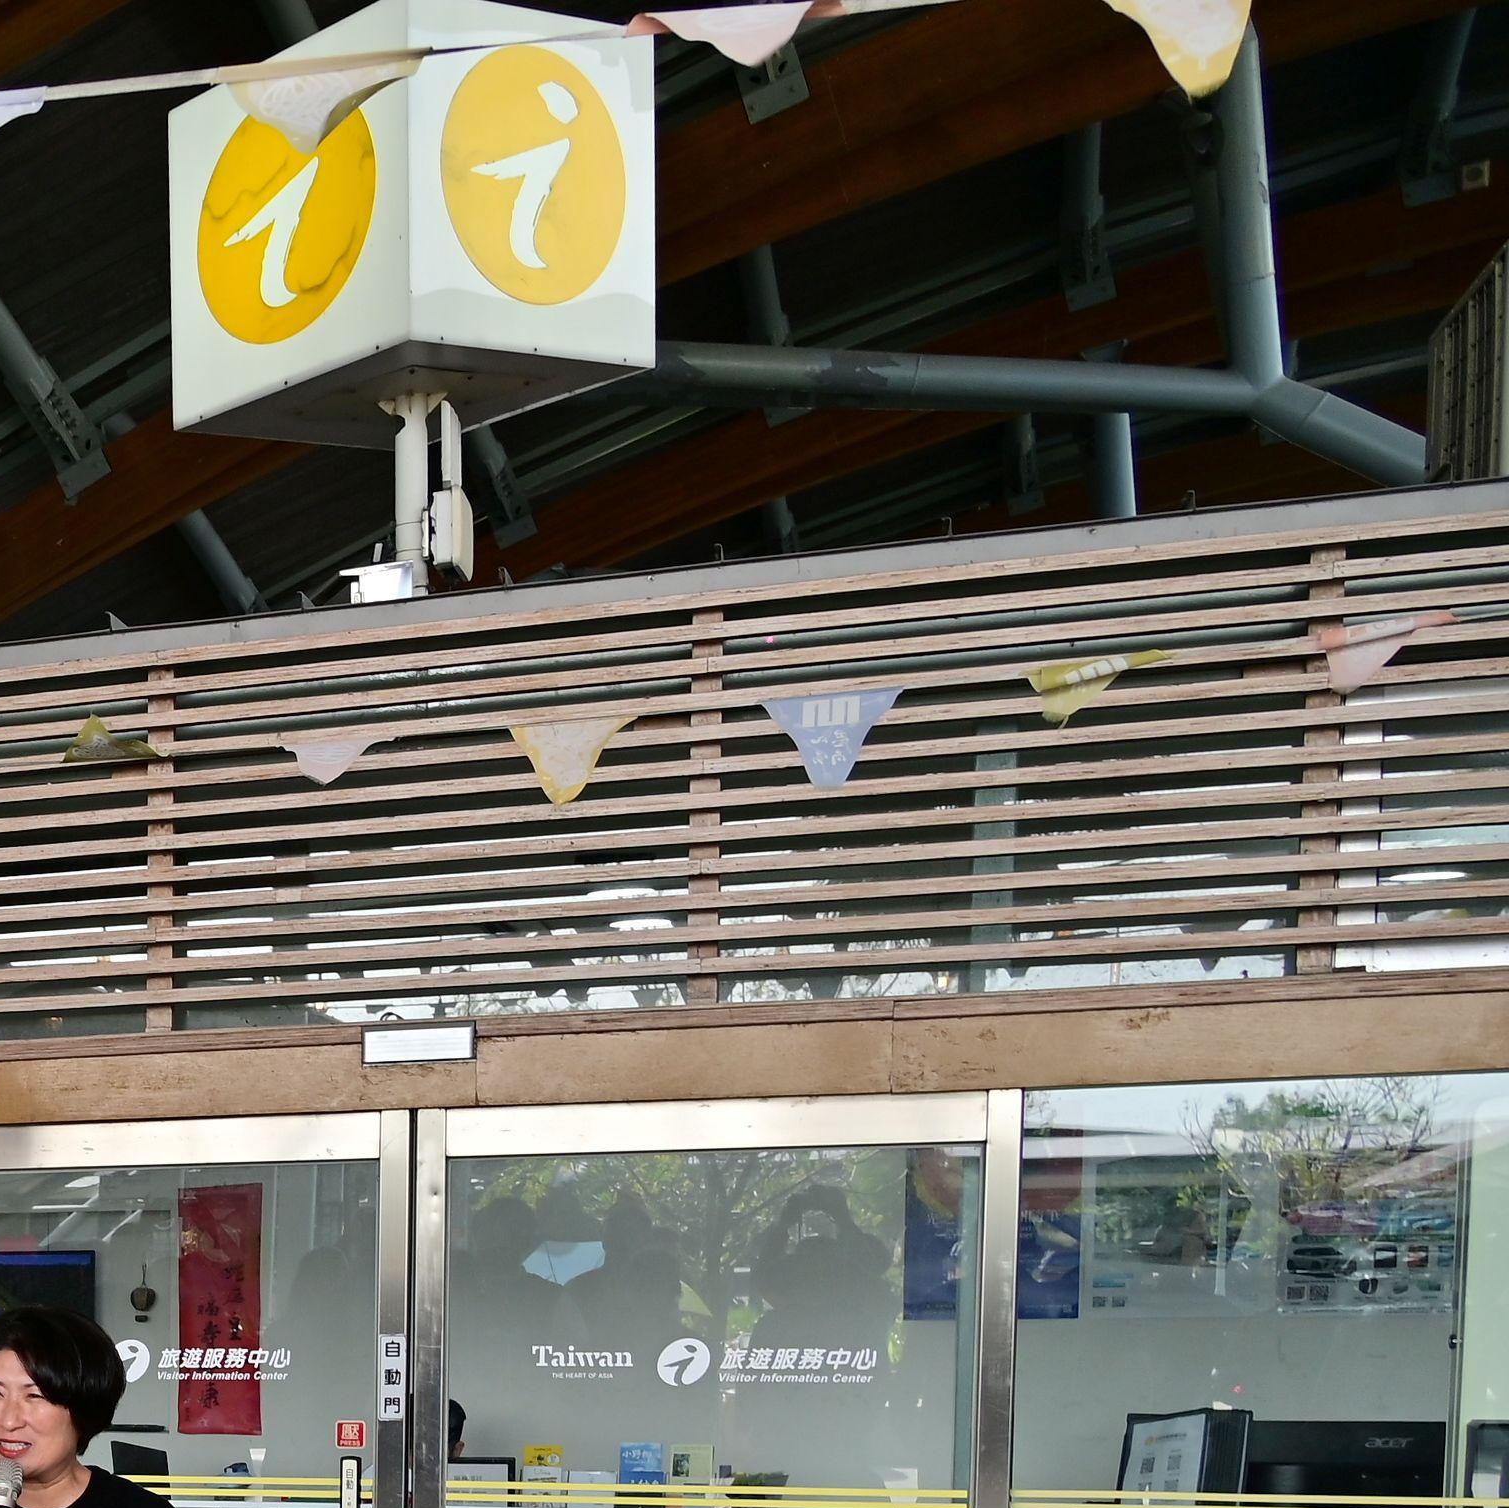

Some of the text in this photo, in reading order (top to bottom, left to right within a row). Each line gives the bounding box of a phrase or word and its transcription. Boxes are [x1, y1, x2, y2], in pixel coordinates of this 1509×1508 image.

[157, 1347, 291, 1370] 旅遊服務中心
[532, 1345, 634, 1369] Taiwan
[719, 1347, 877, 1371] 旅遊服務中心
[156, 1371, 289, 1381] Visitor Information Center
[383, 1339, 402, 1414] 自動門
[718, 1373, 874, 1384] Visitor Information Center
[1364, 1436, 1414, 1449] acer
